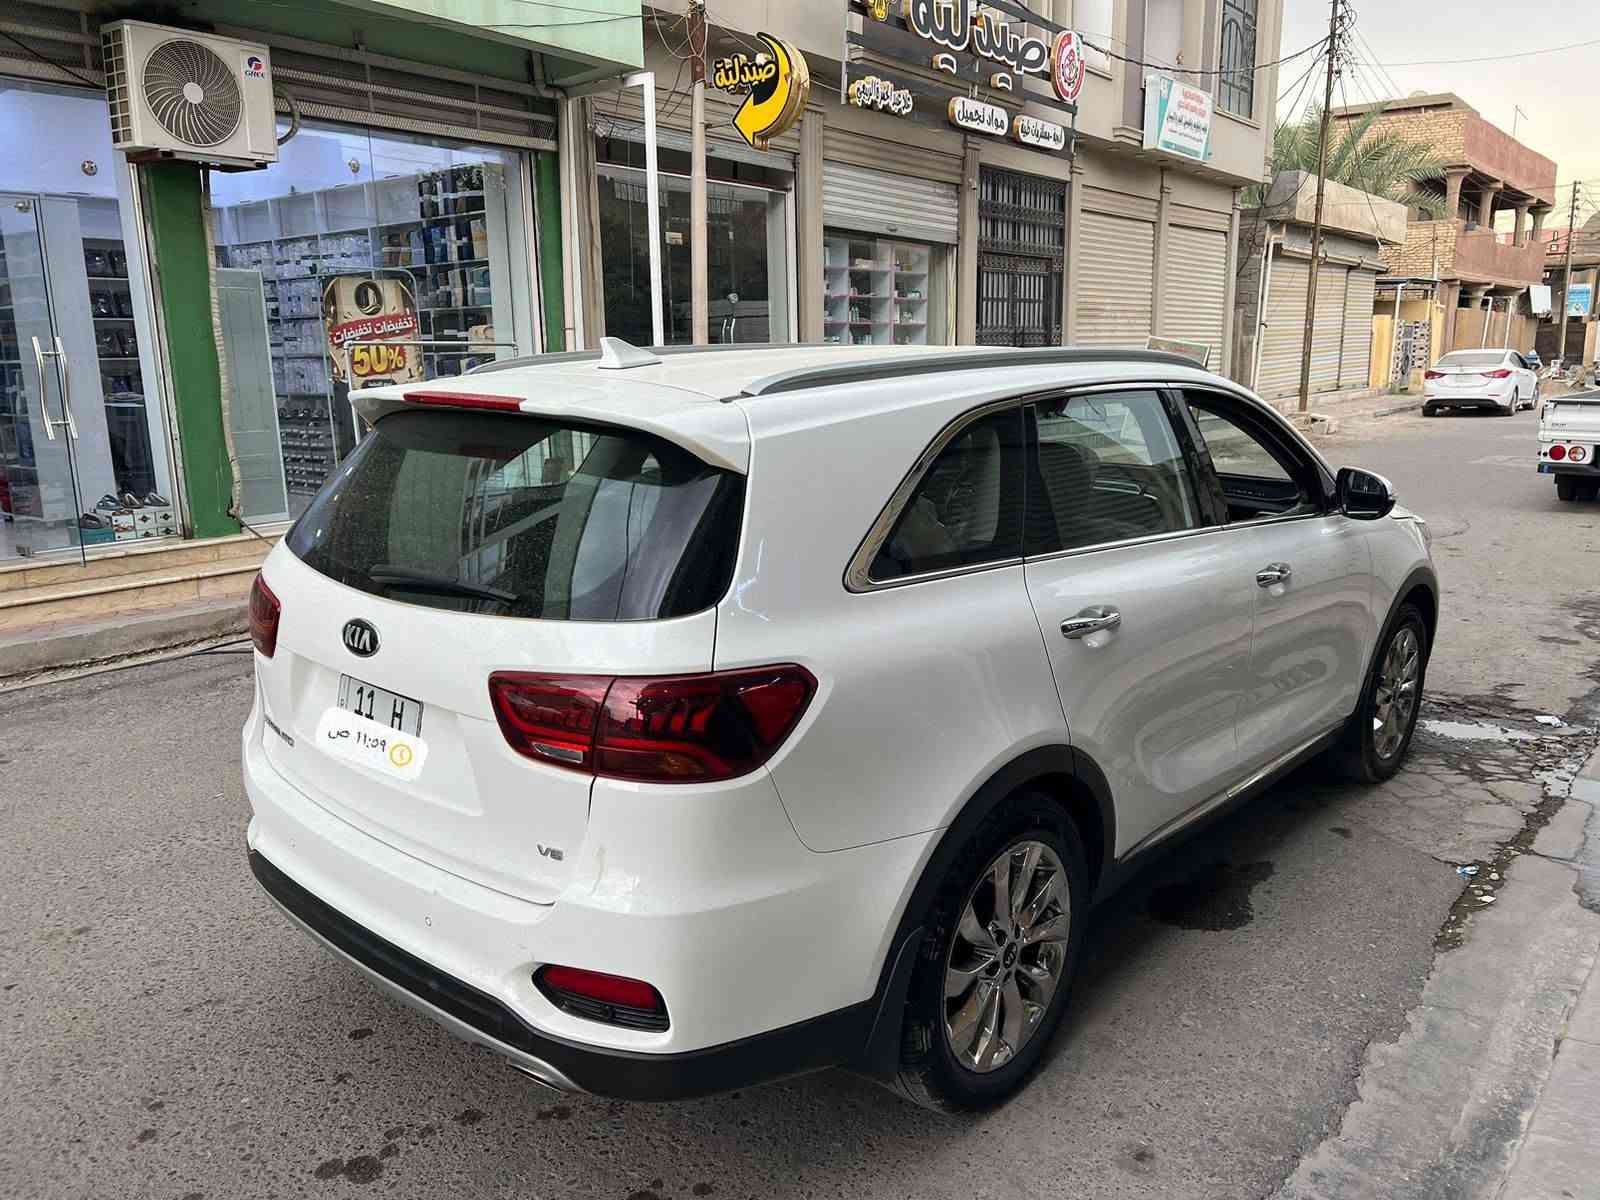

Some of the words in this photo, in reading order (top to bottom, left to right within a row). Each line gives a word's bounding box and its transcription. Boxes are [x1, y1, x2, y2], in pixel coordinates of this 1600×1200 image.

[714, 54, 777, 92] صيدلية
[957, 100, 985, 125] تجميل
[986, 108, 1005, 130] مواد
[333, 321, 373, 344] تخفيضات
[374, 316, 414, 335] تخفيضات
[352, 342, 405, 377] 50%
[344, 623, 372, 652] KIA
[391, 698, 405, 731] H
[536, 844, 564, 861] V6
